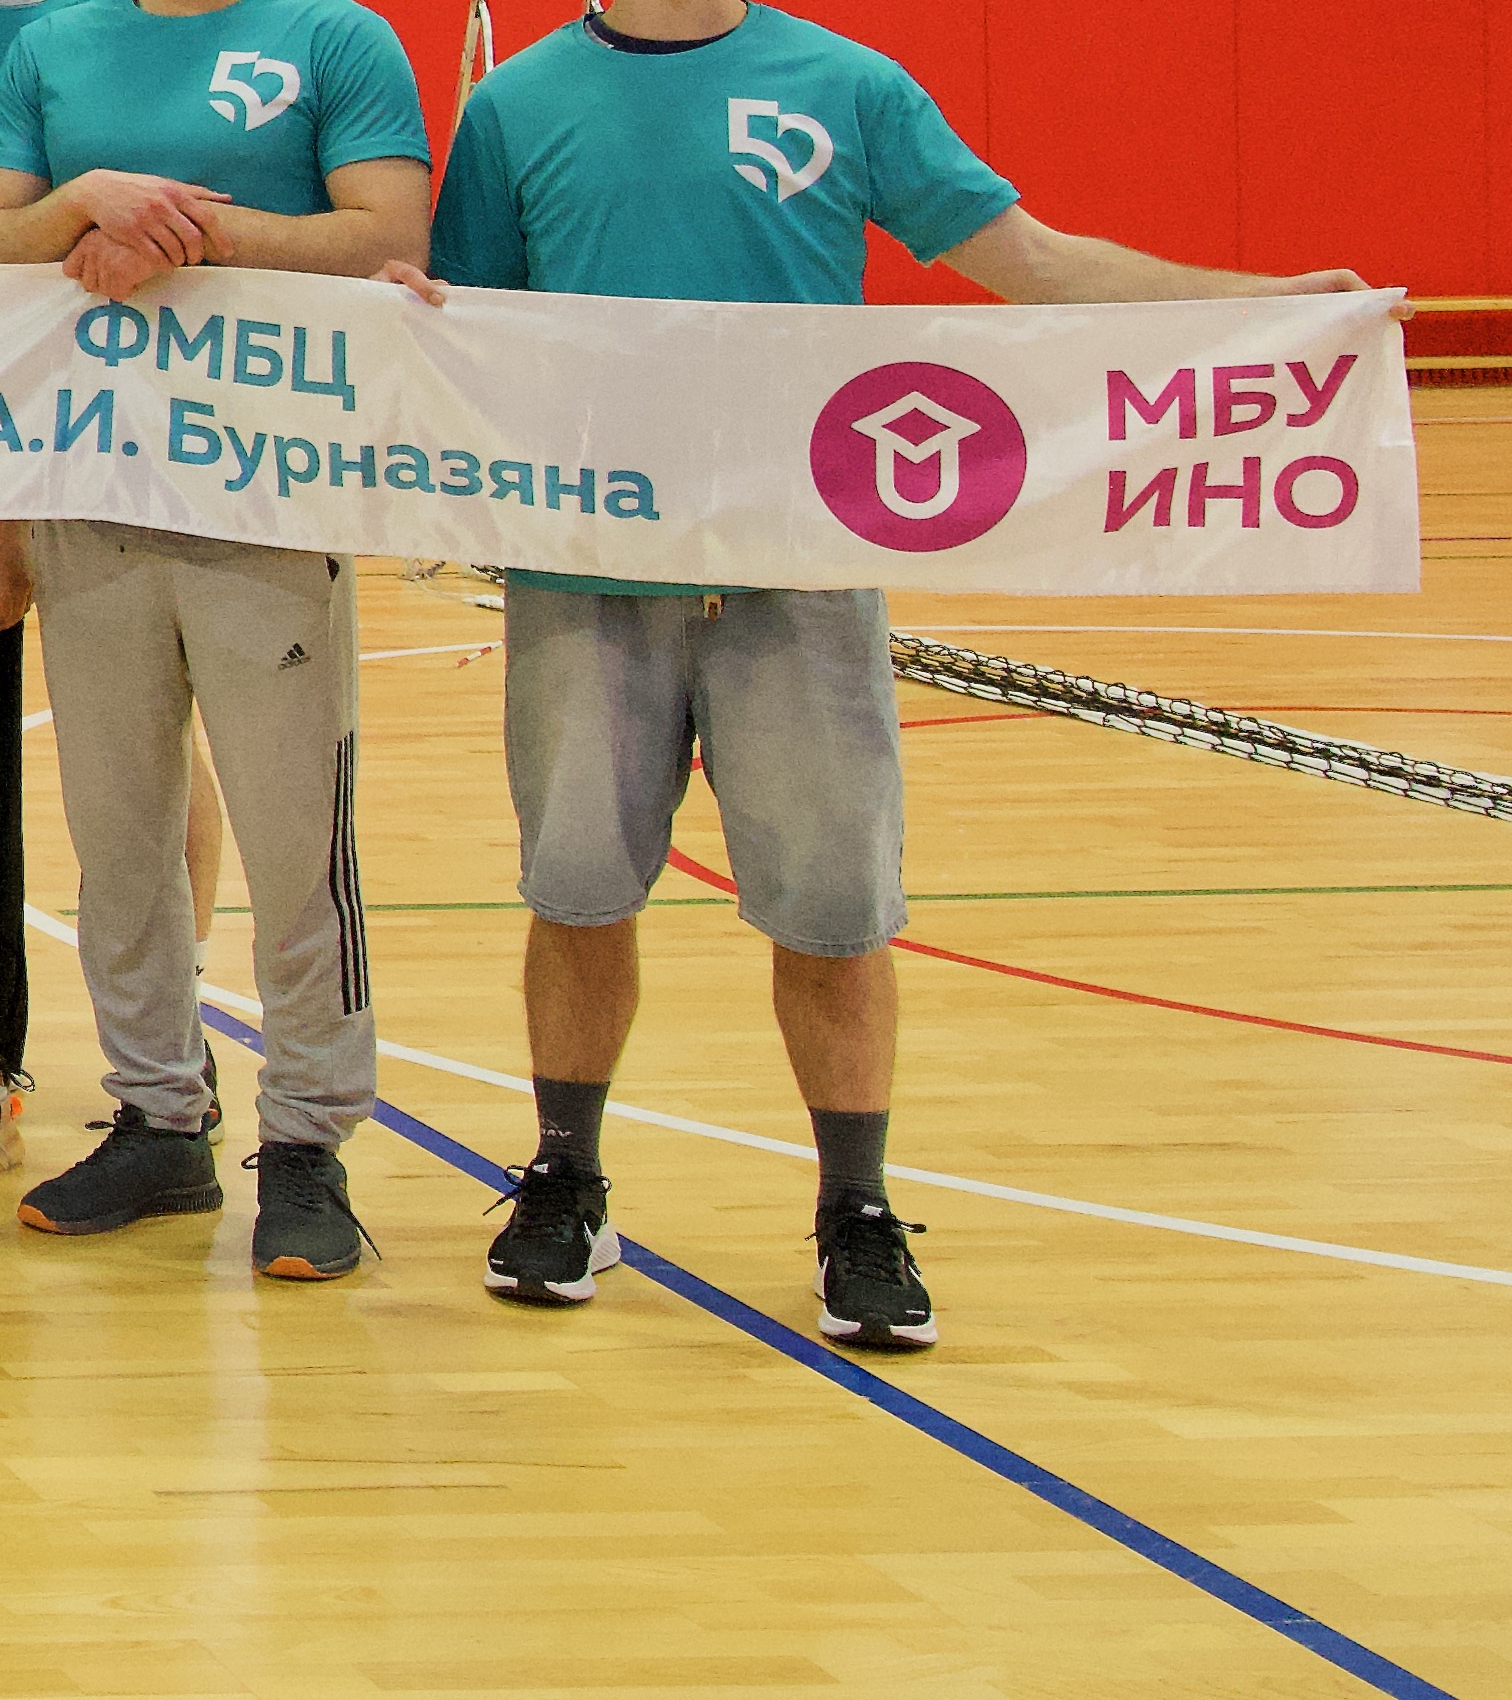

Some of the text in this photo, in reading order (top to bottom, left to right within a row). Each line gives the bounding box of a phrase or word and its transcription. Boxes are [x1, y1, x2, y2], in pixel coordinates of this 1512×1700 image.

[73, 296, 357, 413] ФМБЦ
[1106, 354, 1359, 441] МБУ
[167, 396, 662, 523] Бурназяна
[1103, 455, 1360, 533] ИНО
